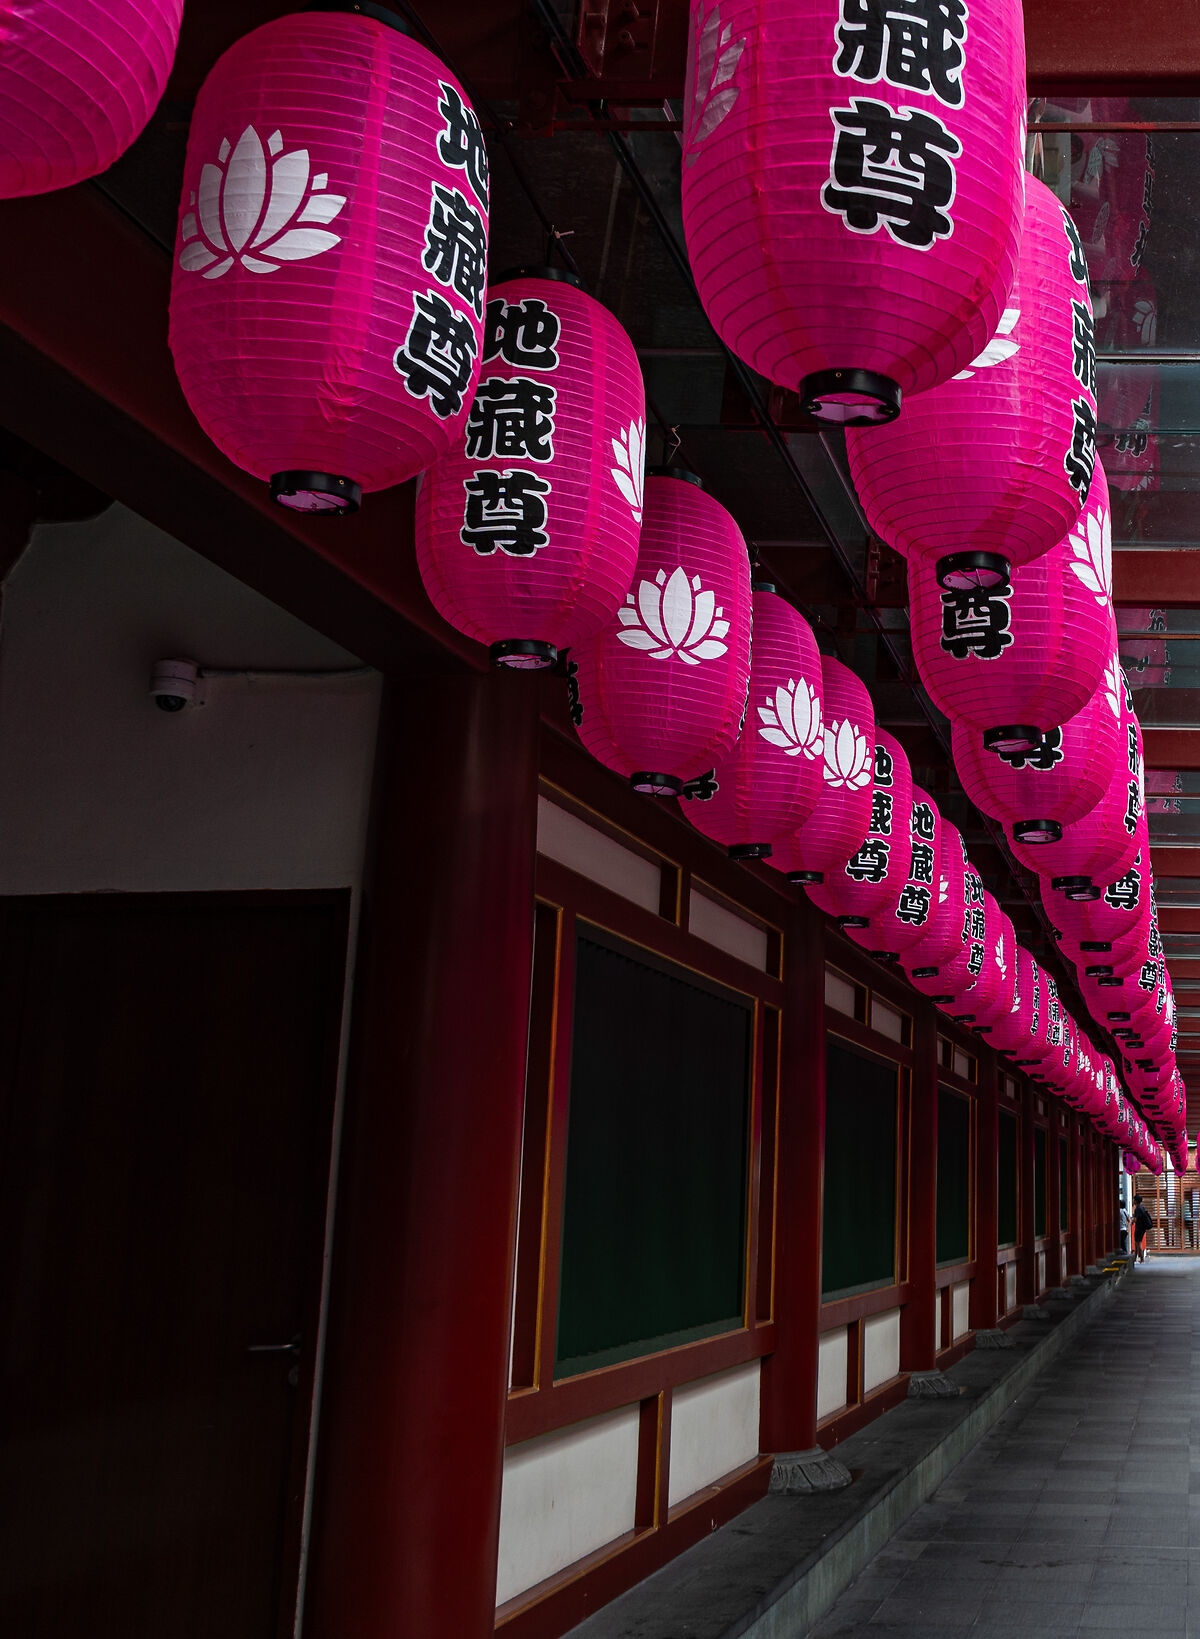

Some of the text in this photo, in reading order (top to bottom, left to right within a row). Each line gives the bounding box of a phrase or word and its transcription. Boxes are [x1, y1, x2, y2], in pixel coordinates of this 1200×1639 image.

[394, 80, 489, 420] 地藏尊
[459, 298, 561, 557] 地藏尊
